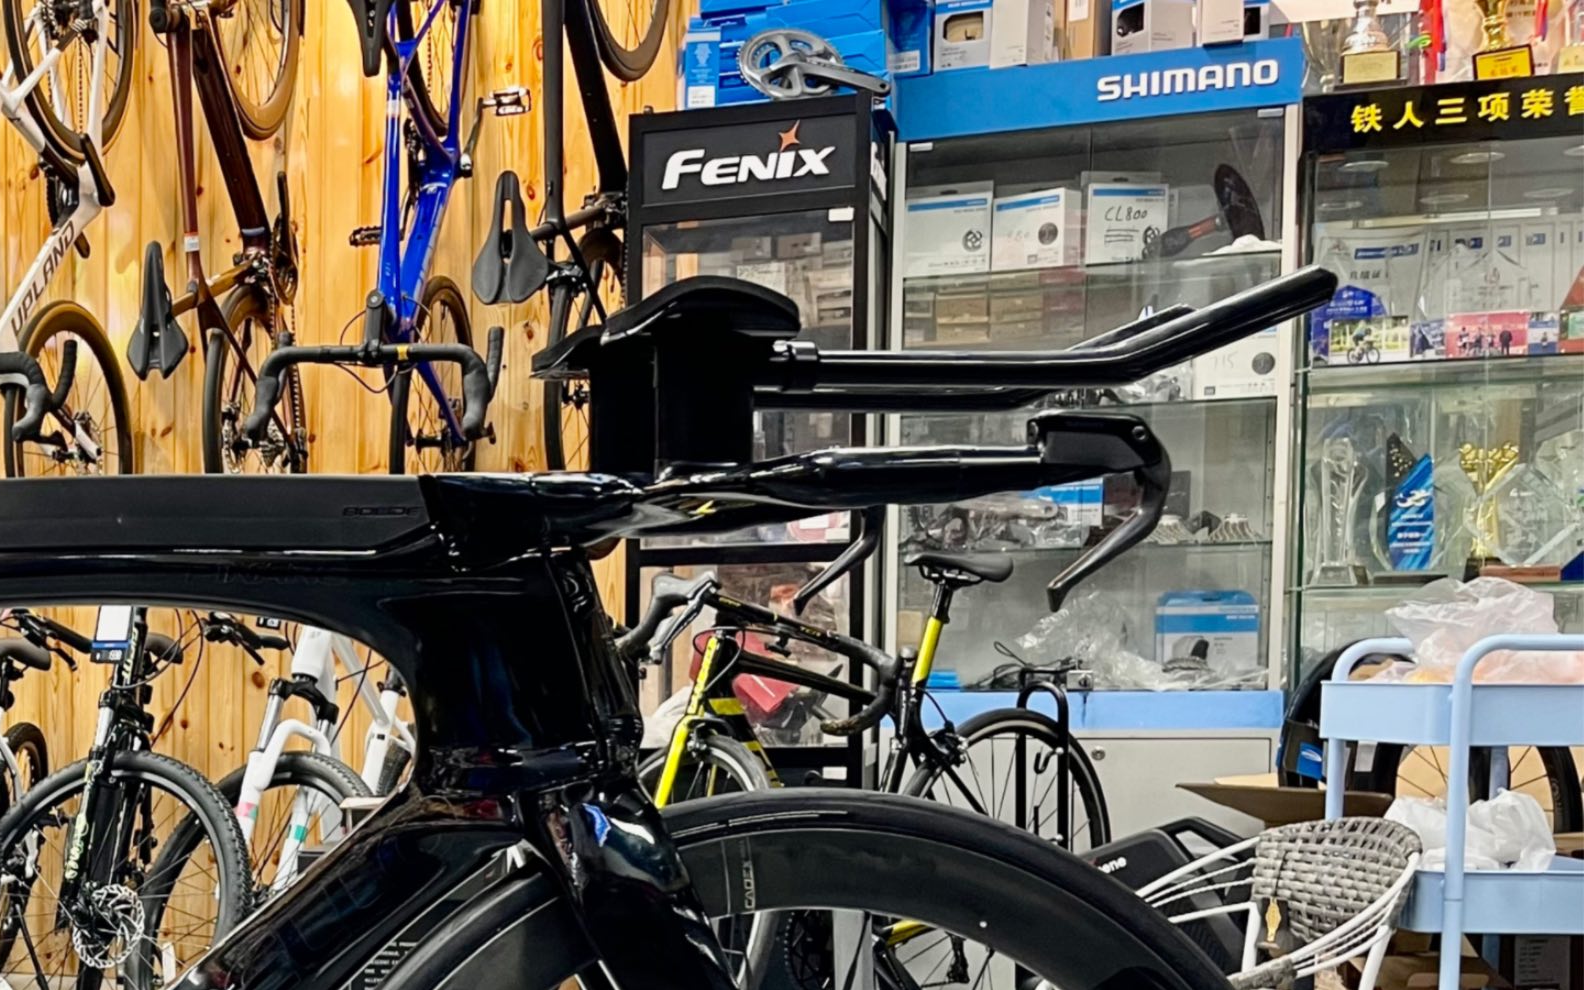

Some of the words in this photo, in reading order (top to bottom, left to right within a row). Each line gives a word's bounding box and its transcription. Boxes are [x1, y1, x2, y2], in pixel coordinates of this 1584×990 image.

[1096, 58, 1279, 102] SHIMANO
[1104, 205, 1148, 222] CL800
[11, 219, 76, 337] UPLAND
